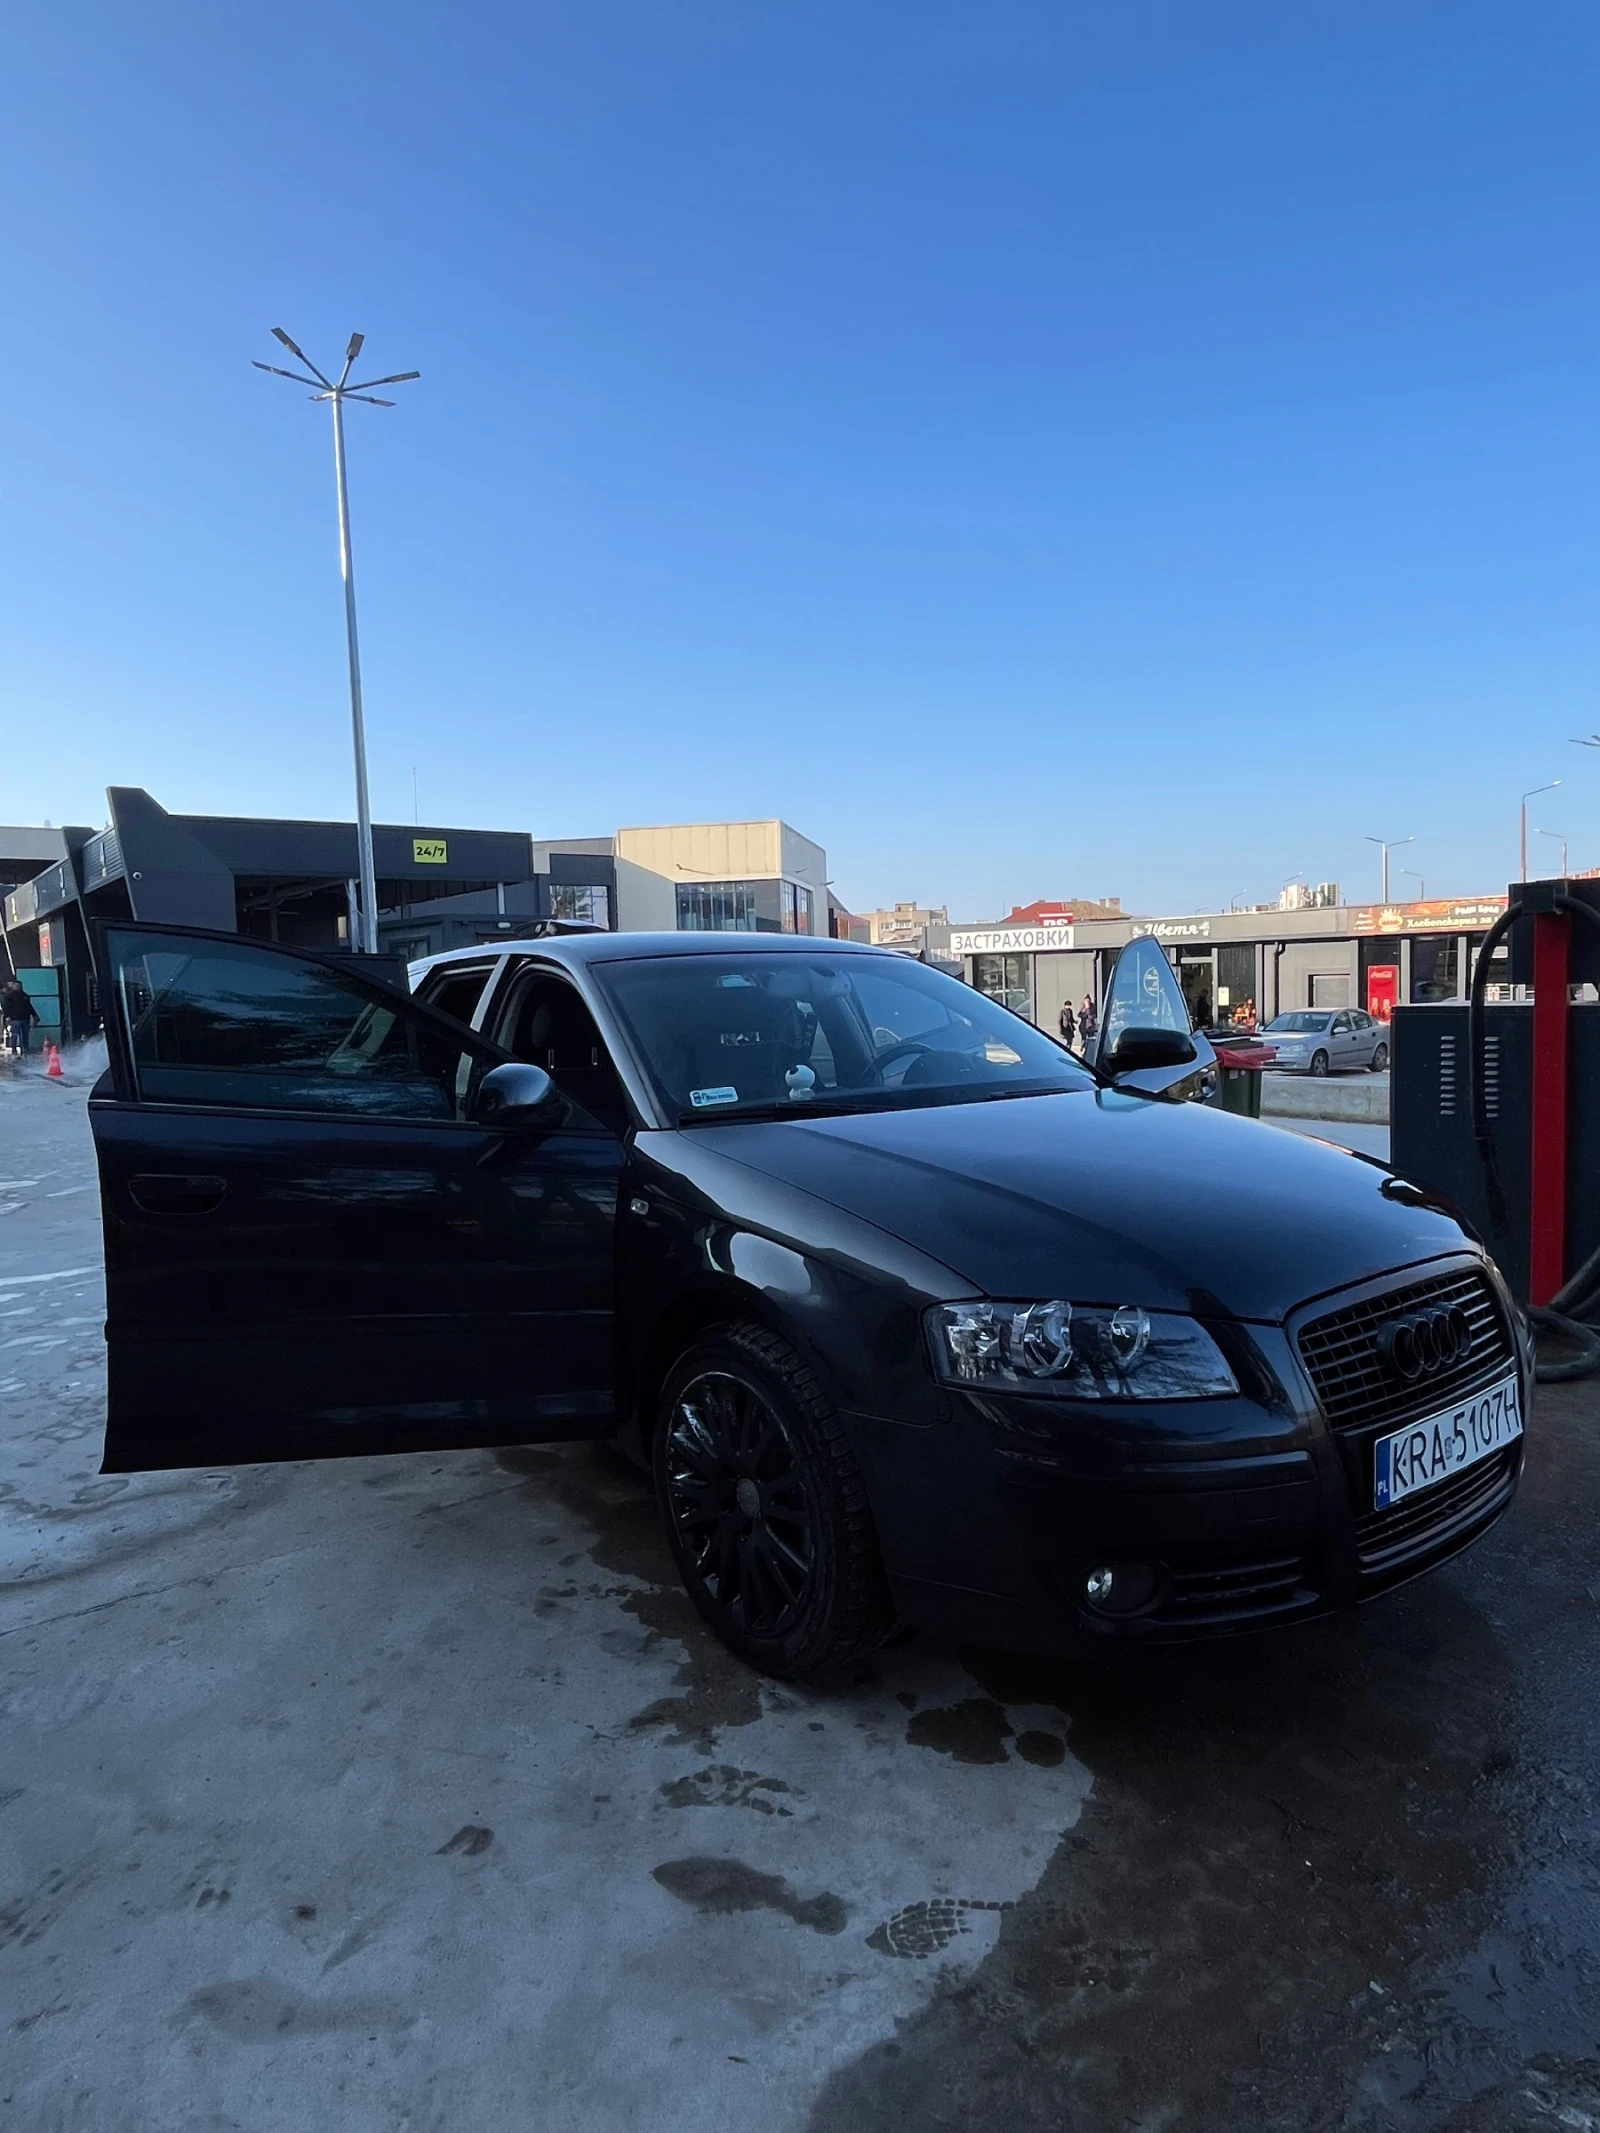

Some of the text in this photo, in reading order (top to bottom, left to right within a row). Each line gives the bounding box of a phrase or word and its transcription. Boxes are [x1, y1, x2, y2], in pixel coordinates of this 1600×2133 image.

[416, 845, 445, 858] 24/7
[1144, 922, 1199, 937] Цветя
[954, 929, 1070, 950] ЗАСТРАХОВКИ
[1392, 1423, 1447, 1493] KRA
[1377, 1480, 1389, 1496] PL
